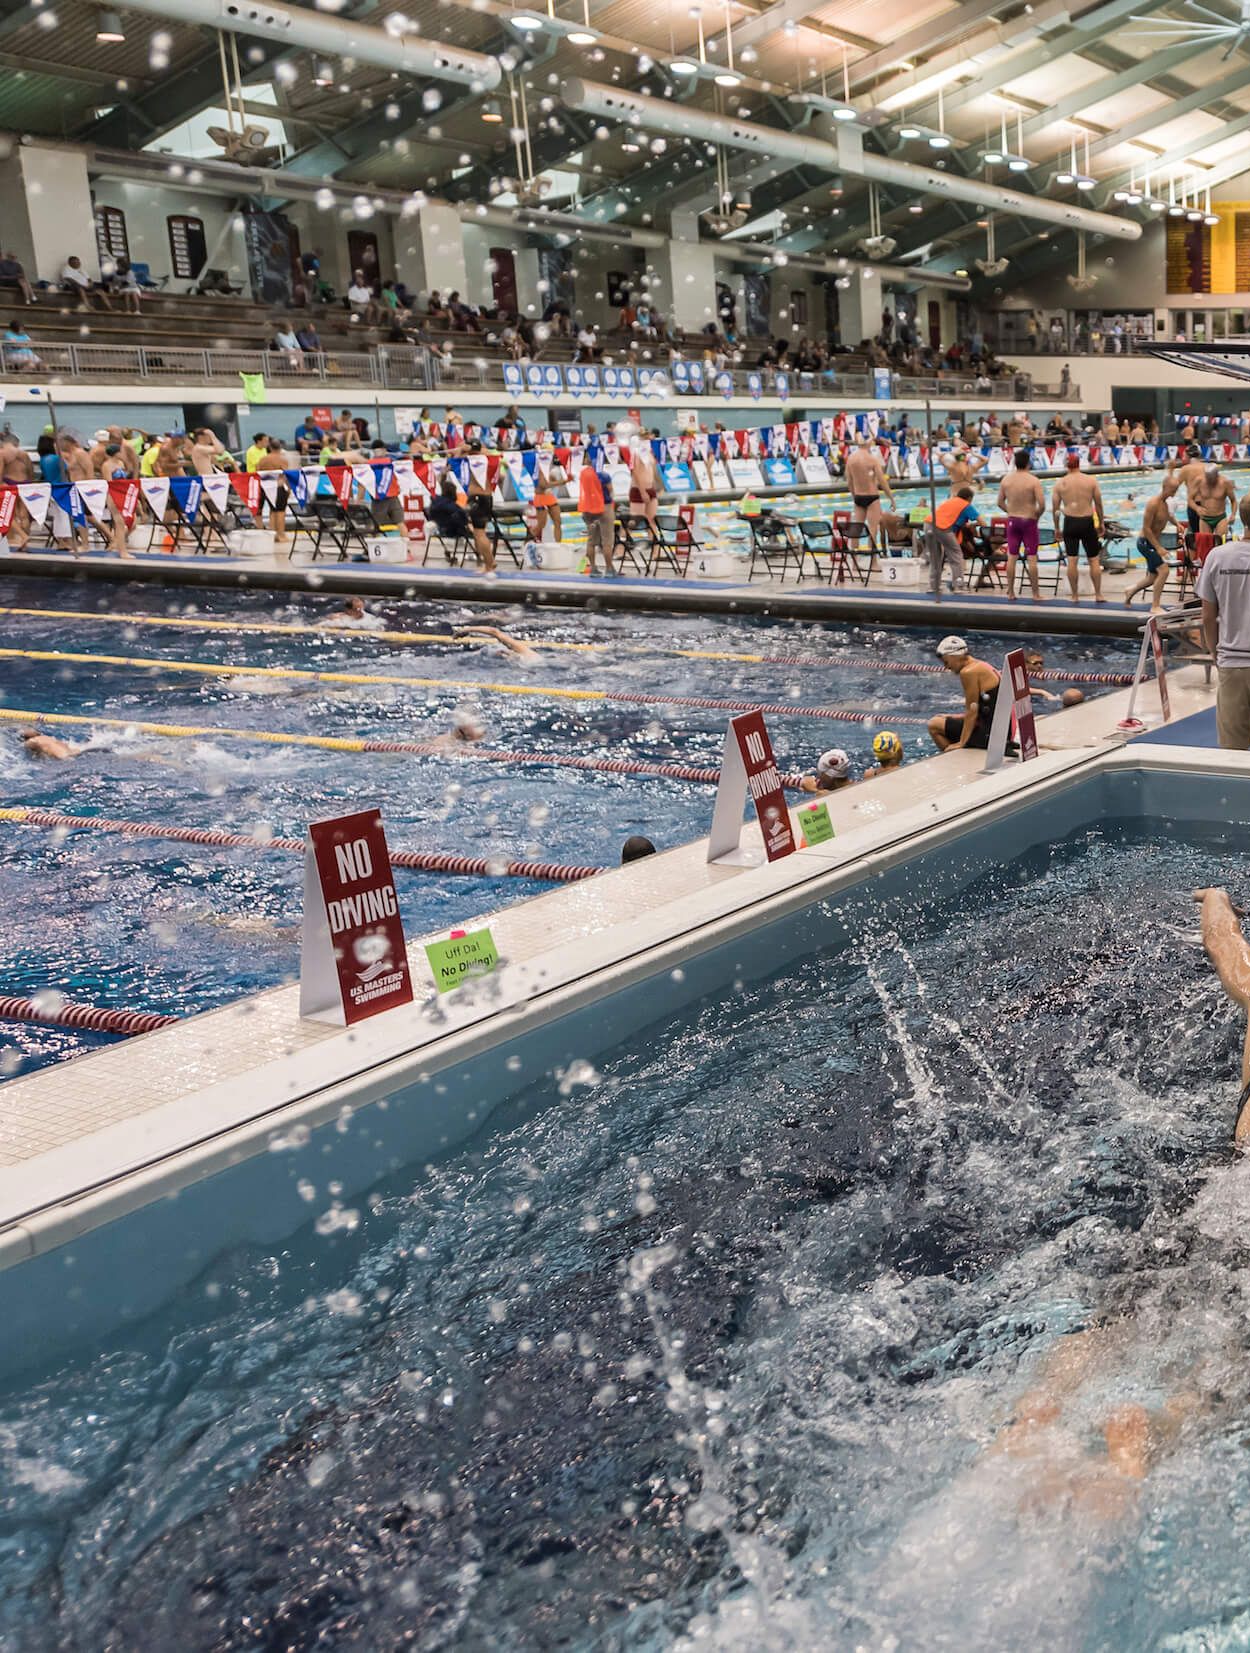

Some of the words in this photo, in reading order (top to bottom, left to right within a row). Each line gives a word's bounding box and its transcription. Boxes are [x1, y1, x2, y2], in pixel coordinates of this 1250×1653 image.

[374, 545, 382, 557] 6
[699, 561, 706, 572] 4
[889, 568, 897, 580] 3
[745, 731, 764, 764] NO
[749, 766, 781, 800] DIVING
[334, 838, 373, 884] NO
[328, 885, 398, 934] DIVING
[364, 971, 404, 993] MASTERS
[441, 964, 457, 978] No
[355, 981, 401, 1005] SWIMMING
